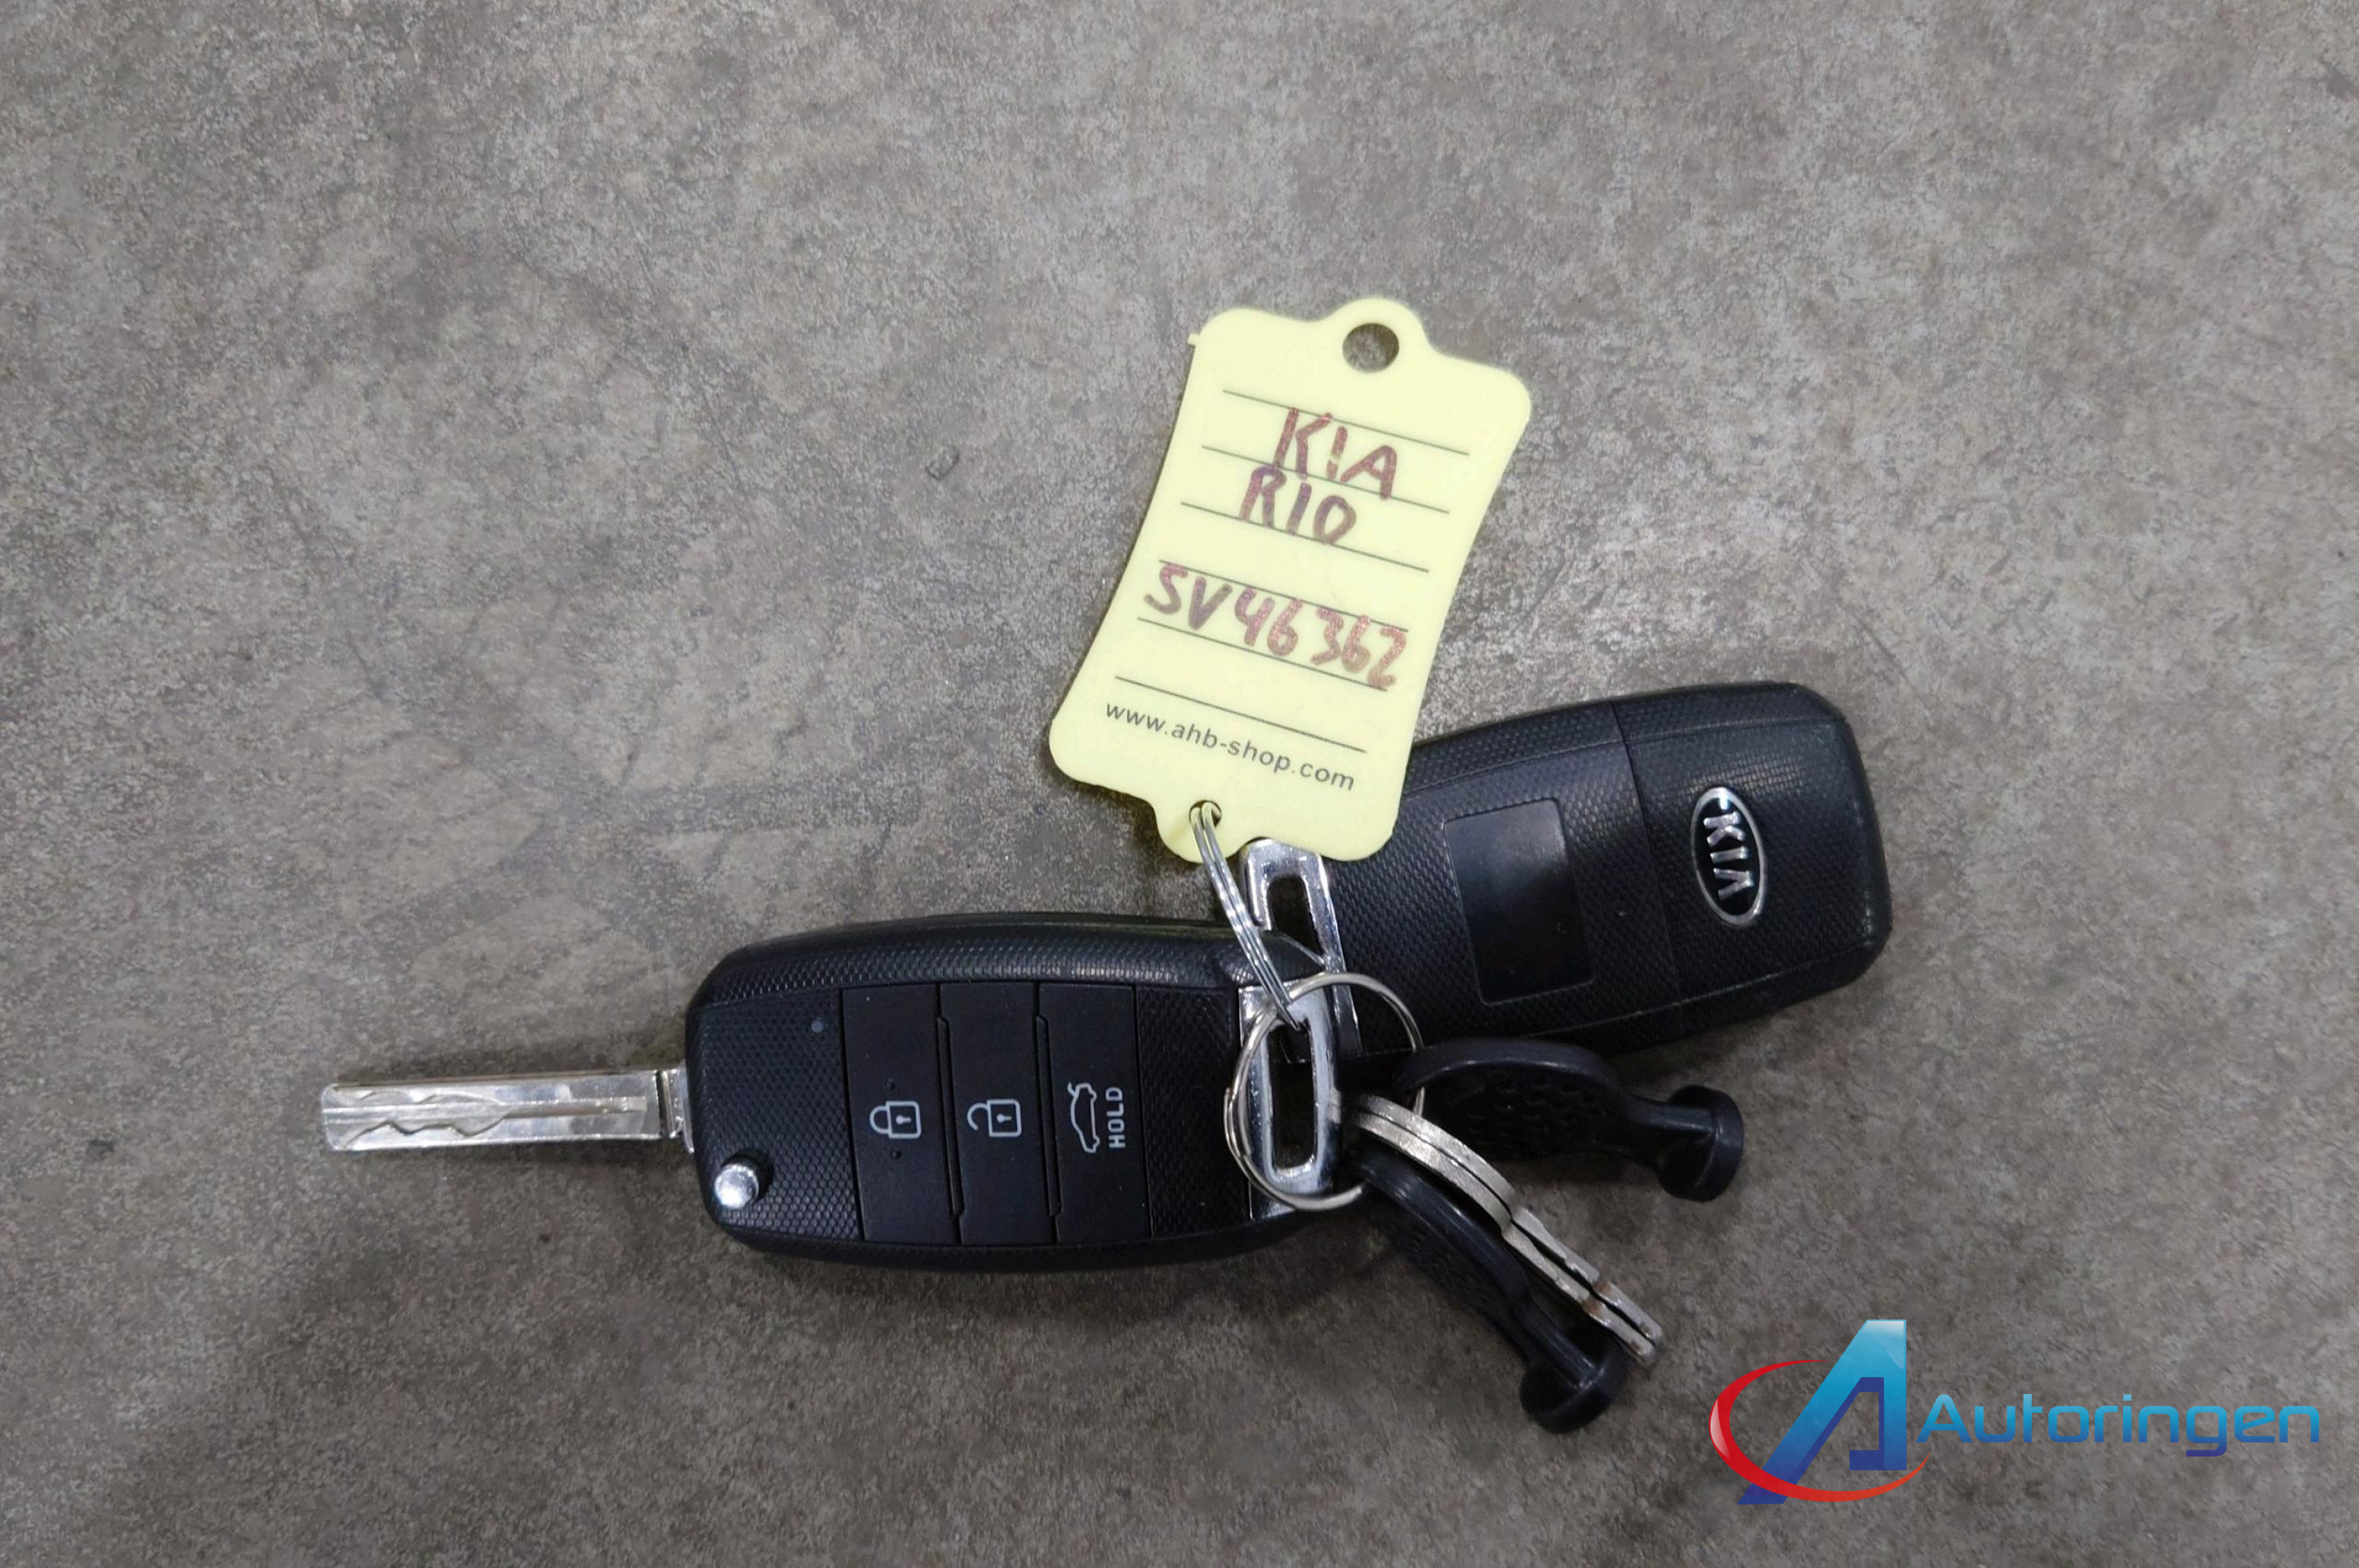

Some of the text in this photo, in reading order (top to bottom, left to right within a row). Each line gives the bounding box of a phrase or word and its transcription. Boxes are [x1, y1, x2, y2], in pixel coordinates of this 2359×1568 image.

[1275, 407, 1398, 500] KIA
[1240, 464, 1358, 544] RIO
[1144, 563, 1408, 689] SV46362
[1105, 703, 1355, 791] www.ahb-shop.com
[1703, 811, 1754, 899] KIA
[1106, 1087, 1125, 1149] HOLD
